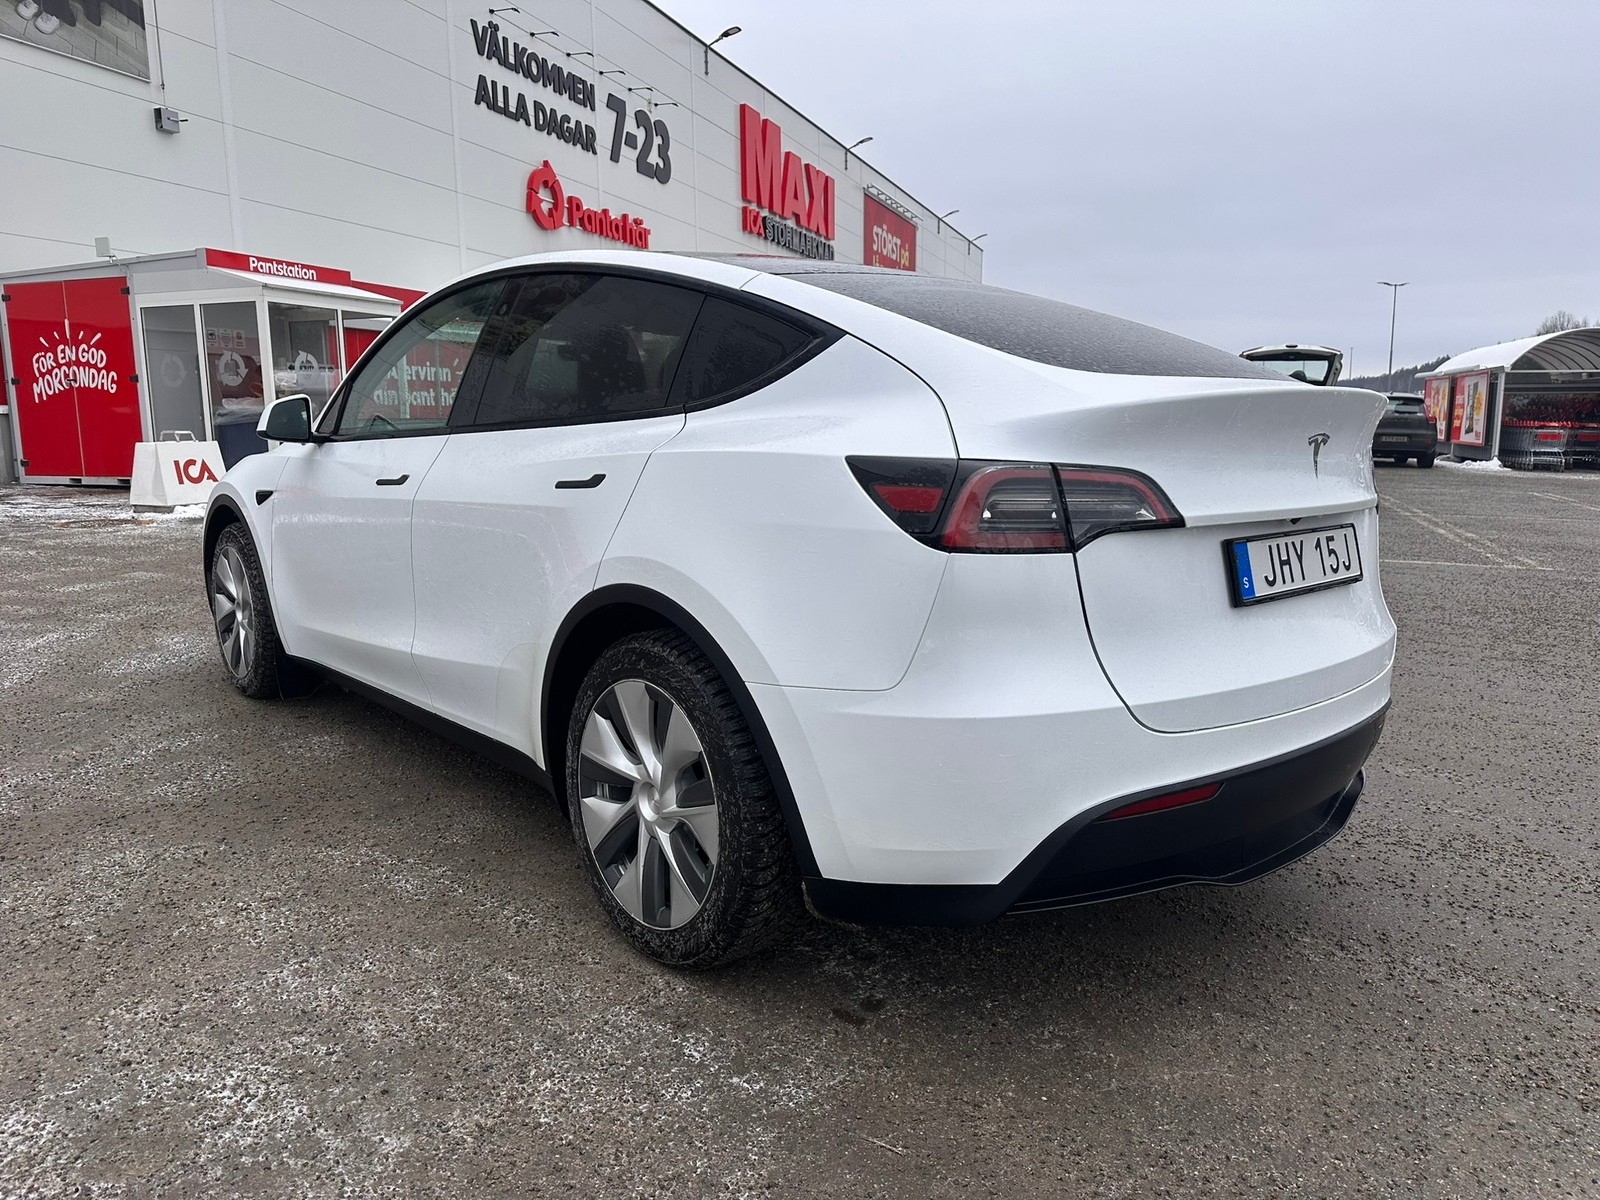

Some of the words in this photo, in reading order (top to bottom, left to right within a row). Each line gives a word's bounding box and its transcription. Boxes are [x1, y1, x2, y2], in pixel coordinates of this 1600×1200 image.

[470, 19, 596, 111] VÄLKOMMEN
[475, 74, 531, 126] ALLA
[534, 100, 597, 155] DAGAR
[606, 93, 671, 184] 7-23
[740, 103, 835, 241] MAXI
[567, 196, 623, 240] Panta
[622, 213, 651, 249] här
[742, 205, 765, 238] ICA
[249, 256, 317, 281] Pantstation
[872, 223, 901, 262] STÖRST
[901, 243, 910, 269] på
[32, 352, 56, 377] FÖR
[57, 344, 76, 364] EN
[78, 343, 107, 368] GOD
[32, 365, 118, 403] MORGONDAG
[173, 458, 218, 485] ICA
[1243, 577, 1249, 589] S
[1264, 539, 1306, 587] JHY
[1314, 533, 1351, 577] 15J
